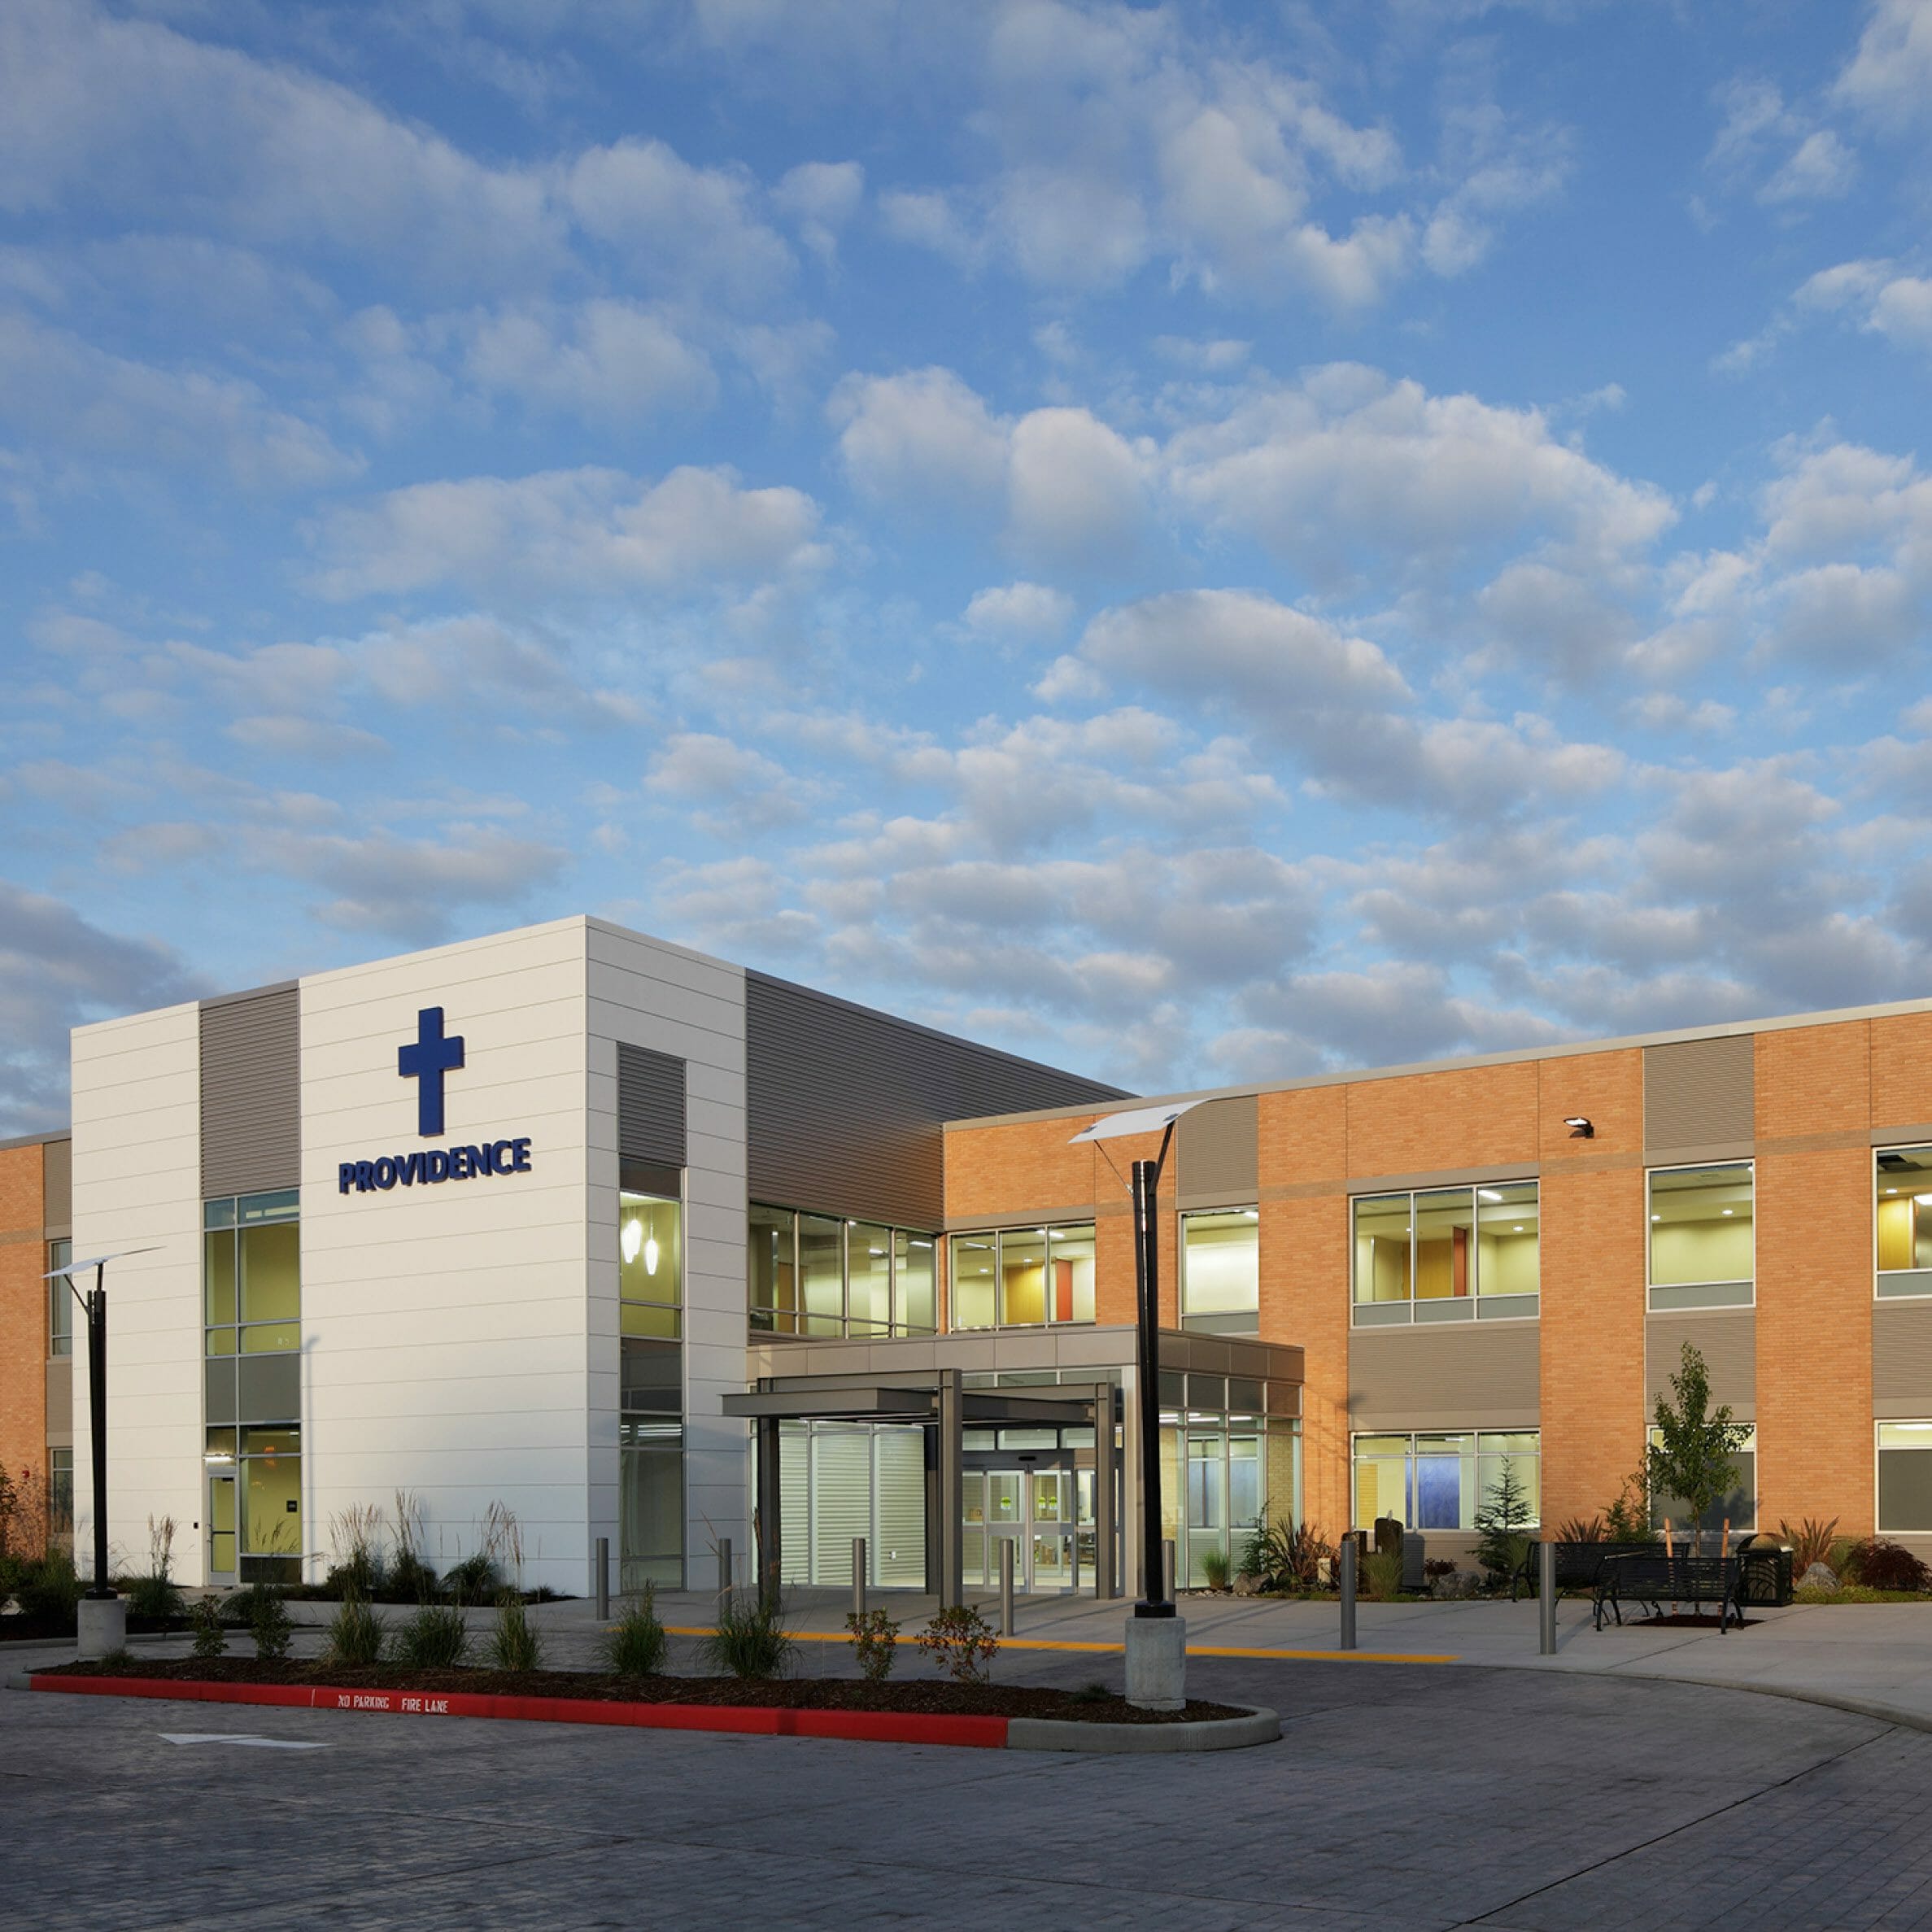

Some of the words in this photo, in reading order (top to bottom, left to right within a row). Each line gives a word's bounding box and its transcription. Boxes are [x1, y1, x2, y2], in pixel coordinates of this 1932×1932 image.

[338, 1137, 532, 1194] PROVIDENCE
[338, 1694, 351, 1708] NO
[353, 1695, 390, 1709] PARKING
[401, 1698, 421, 1711] FIRE
[425, 1699, 448, 1714] LANE
